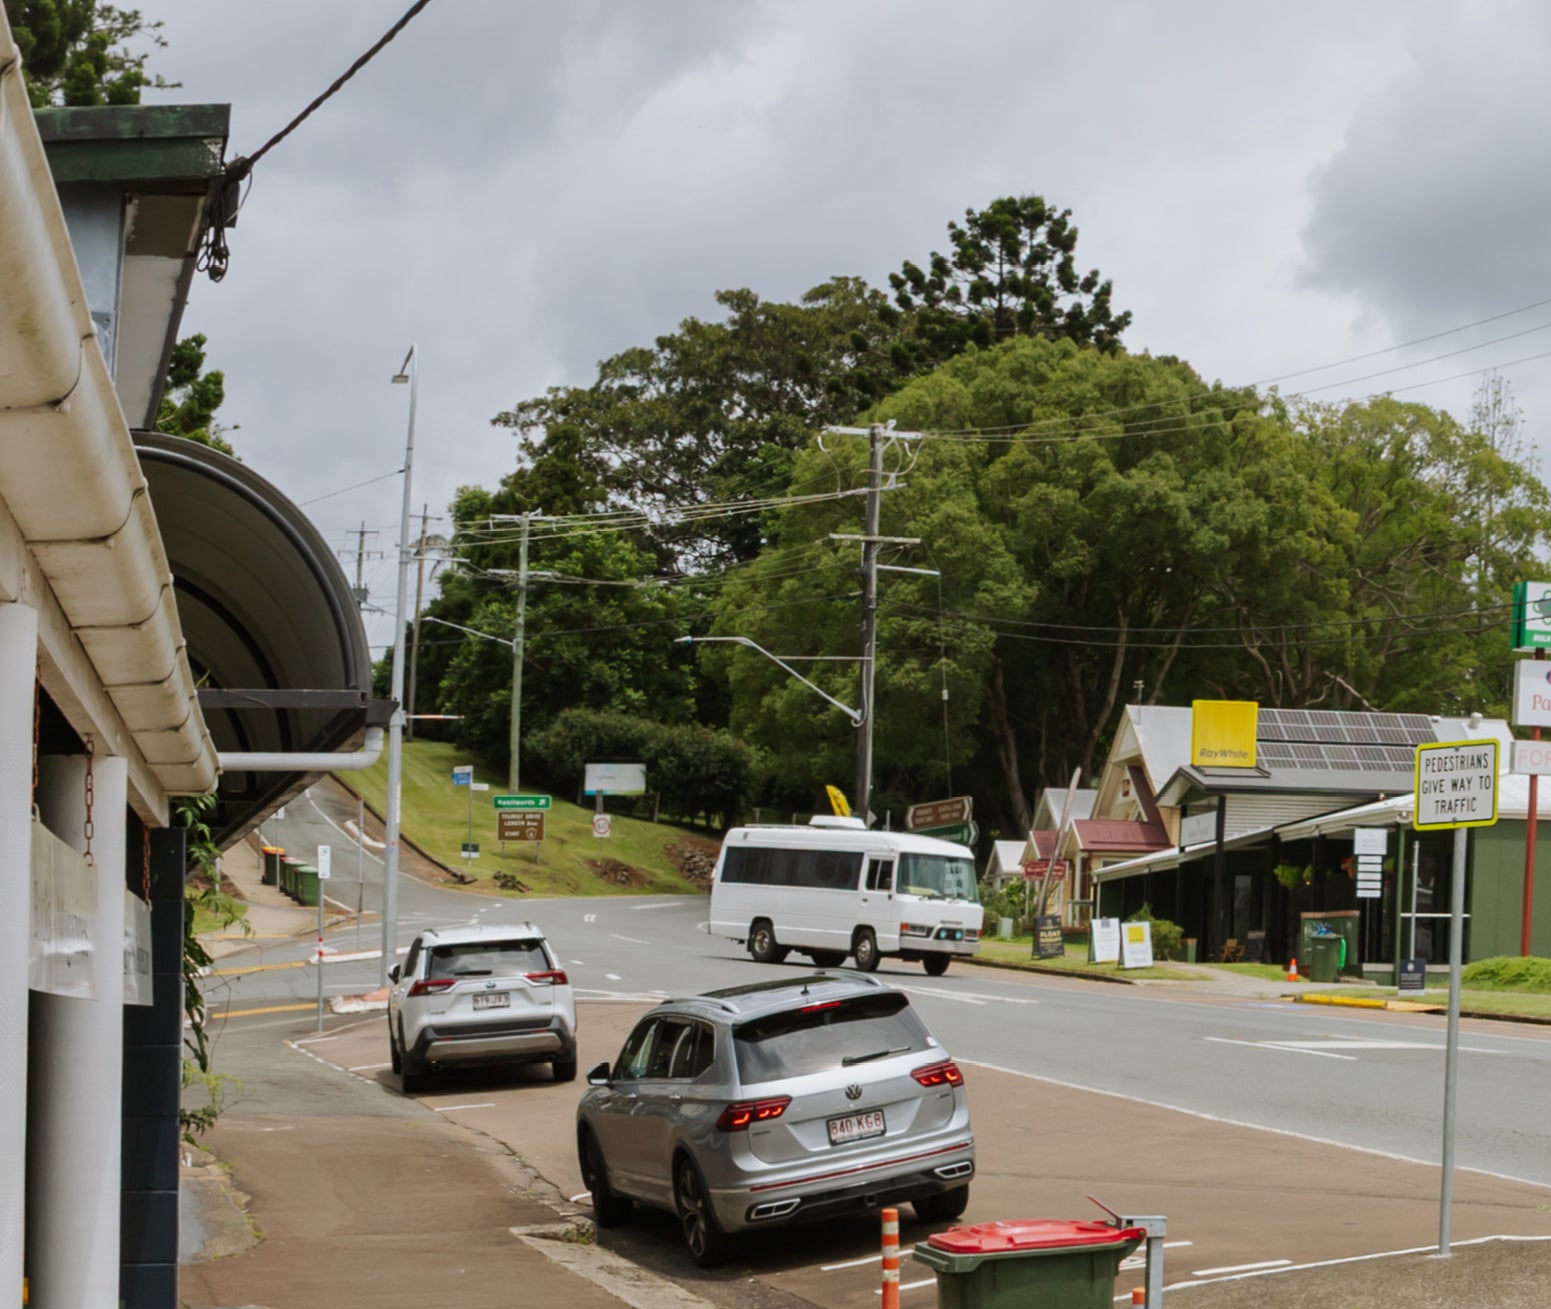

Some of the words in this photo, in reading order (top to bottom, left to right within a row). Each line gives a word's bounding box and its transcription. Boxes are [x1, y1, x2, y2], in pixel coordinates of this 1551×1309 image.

[1425, 753, 1489, 773] PEDESTRIANS
[1422, 778, 1445, 795] GIVE
[1451, 776, 1472, 792] WAY
[1479, 775, 1491, 790] TO
[1435, 797, 1477, 814] TRAFFIC
[830, 1119, 853, 1135] 840
